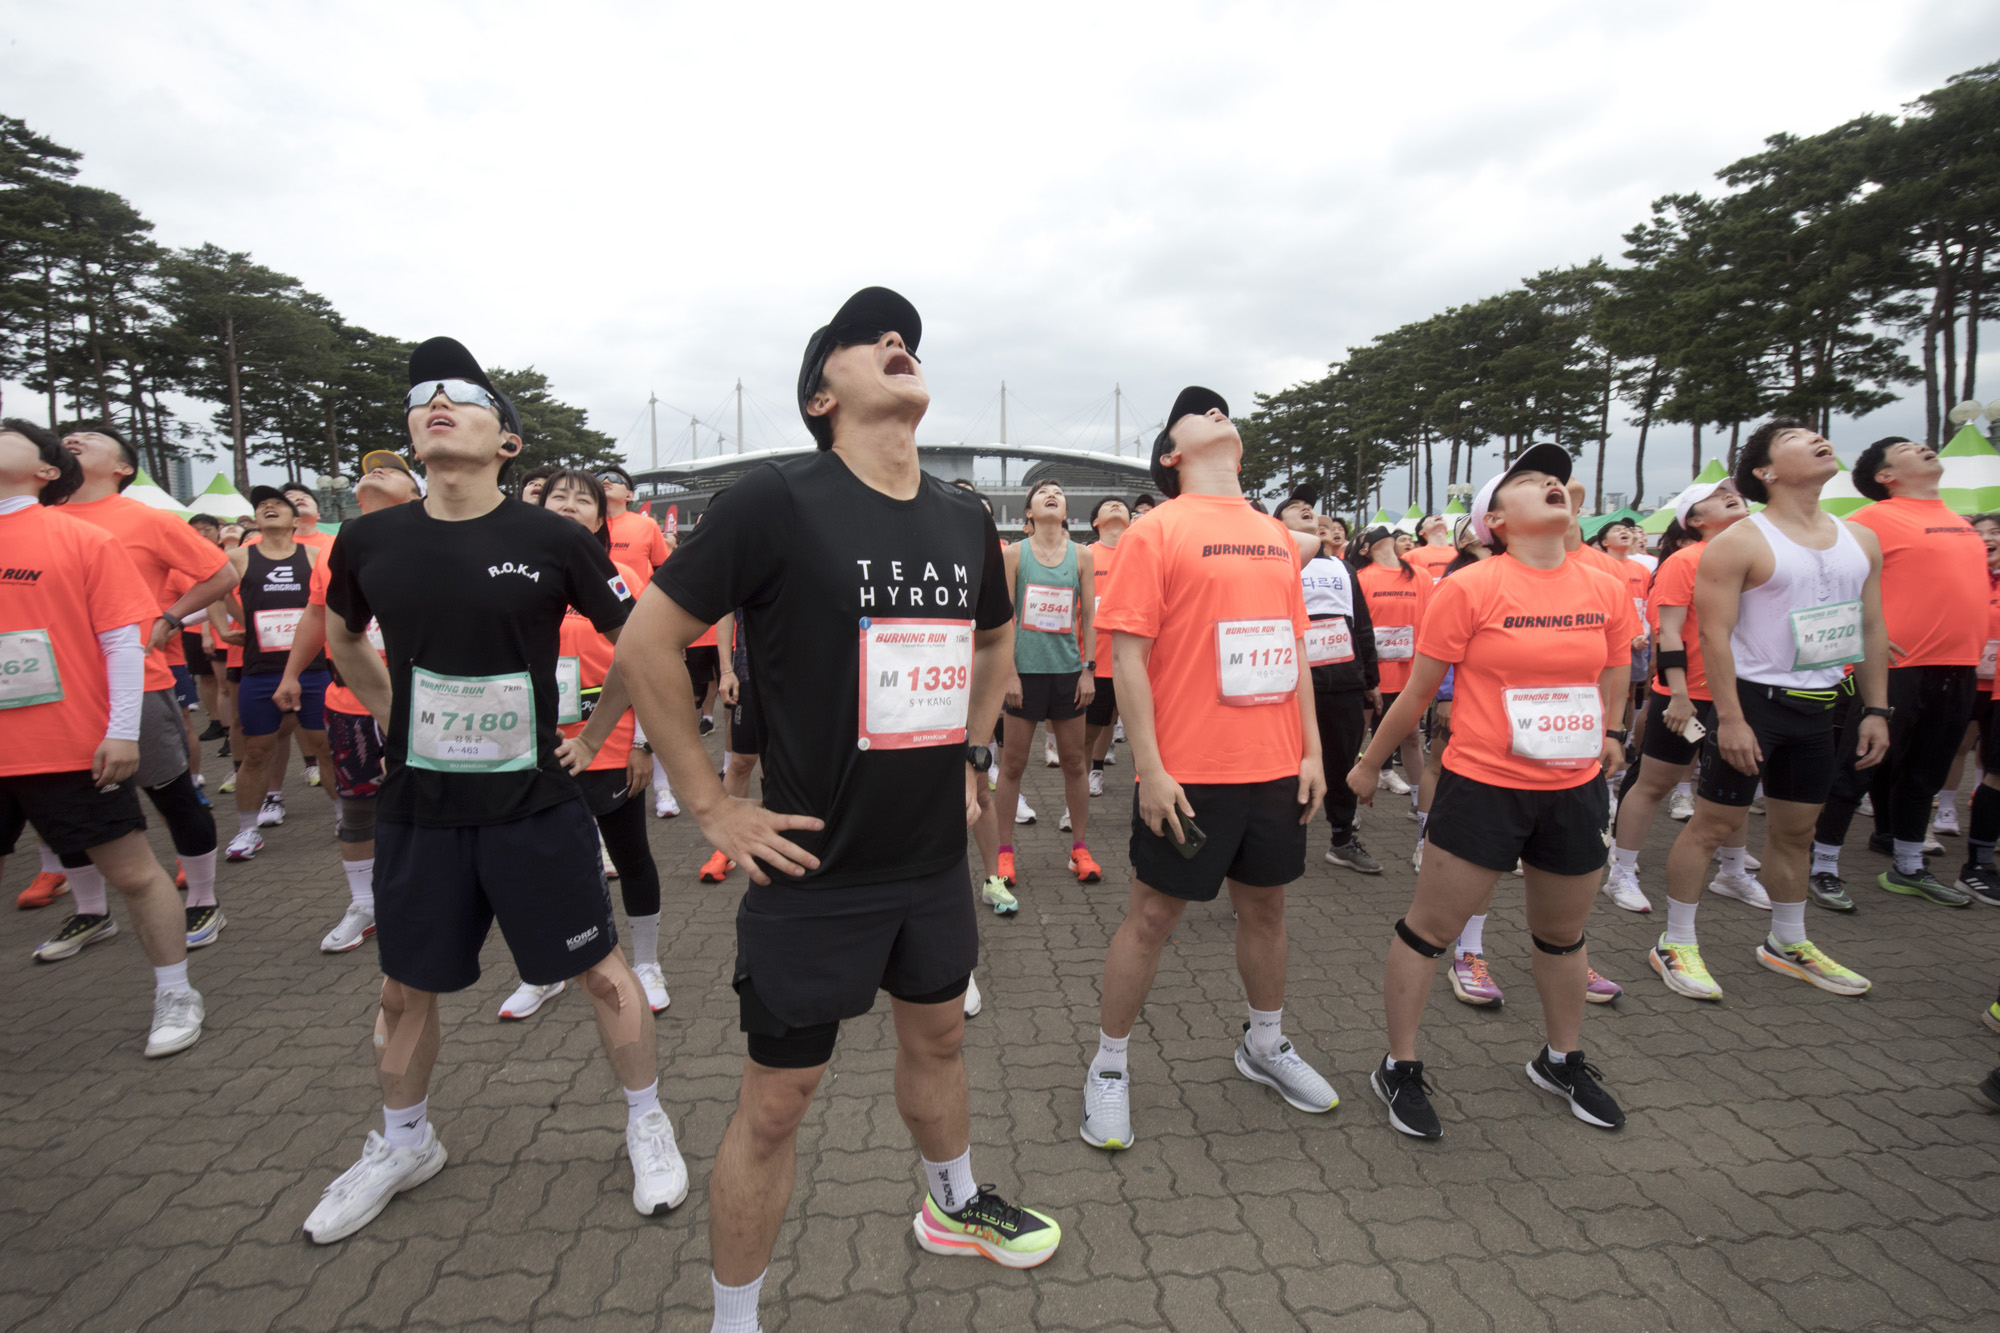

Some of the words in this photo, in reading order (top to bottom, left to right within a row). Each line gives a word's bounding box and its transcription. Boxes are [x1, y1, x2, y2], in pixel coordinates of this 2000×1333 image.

[1202, 543, 1265, 558] BURNING
[1267, 545, 1289, 560] RUN
[1, 568, 43, 582] RUN
[487, 561, 541, 583] R.O.K.A
[857, 560, 968, 584] TEAM
[860, 586, 968, 608] HYROX
[1372, 590, 1403, 598] BURNING
[1039, 602, 1070, 614] 3544
[1502, 615, 1573, 629] BURNING
[1575, 612, 1605, 626] RUN
[875, 632, 926, 644] BURNING
[927, 632, 948, 643] RUN
[1225, 626, 1260, 635] BURNING
[1261, 625, 1276, 634] RUN
[1804, 633, 1814, 643] M
[1817, 623, 1856, 643] 7270
[1309, 638, 1317, 646] M
[1320, 632, 1348, 646] 1590
[1229, 653, 1244, 665] M
[1249, 647, 1293, 667] 1172
[0, 657, 40, 676] 62
[879, 670, 899, 688] M
[907, 665, 967, 691] 1339
[419, 679, 459, 693] BURNING
[461, 686, 486, 695] RUN
[503, 684, 522, 693] 7km
[909, 698, 915, 708] S
[918, 698, 924, 706] Y
[927, 696, 952, 707] KANG
[1512, 693, 1550, 702] BURNING
[1551, 692, 1570, 700] RUN
[420, 710, 435, 725] M
[441, 711, 519, 732] 7180
[1517, 718, 1532, 730] W
[1537, 714, 1595, 732] 3088
[447, 745, 479, 755] A-463
[566, 925, 599, 946] KOREA
